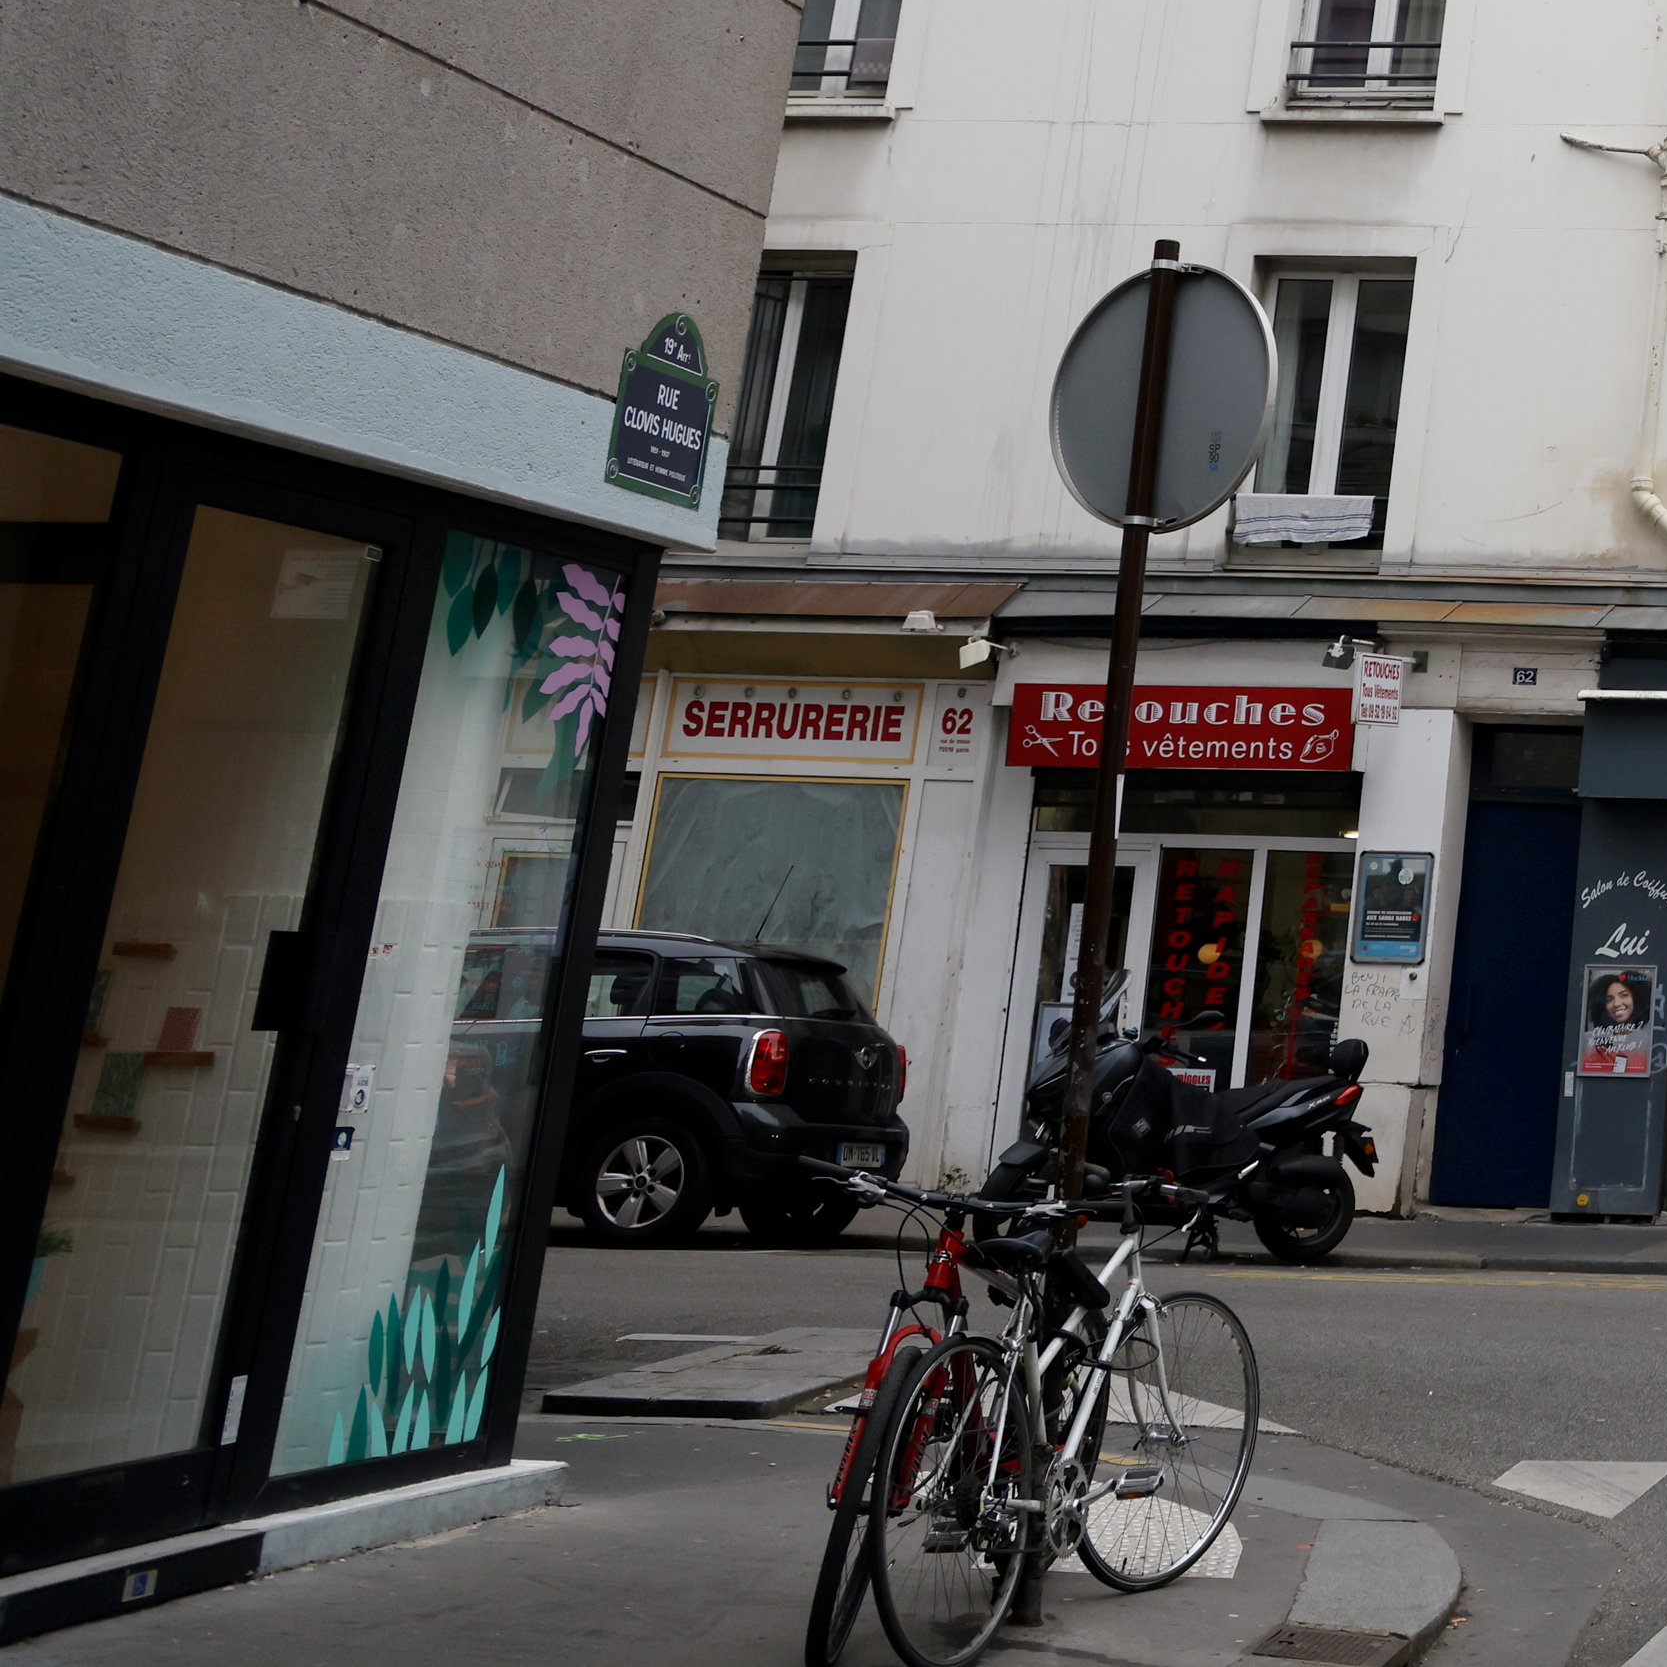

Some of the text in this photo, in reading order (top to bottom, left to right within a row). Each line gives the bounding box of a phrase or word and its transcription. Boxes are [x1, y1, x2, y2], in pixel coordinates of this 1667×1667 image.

[656, 383, 681, 411] RUE
[624, 405, 702, 450] CLOVIS HUGUES
[1364, 660, 1400, 680] RETOUCHES
[1516, 670, 1535, 683] 62
[1362, 682, 1373, 698] Tous
[682, 700, 906, 742] SERRURERIE
[942, 708, 973, 735] 62
[1039, 690, 1326, 727] Reouches
[1142, 733, 1293, 760] vêtements
[1581, 879, 1613, 909] Salon
[1616, 871, 1630, 887] de
[1595, 922, 1650, 958] Lui
[1361, 1011, 1391, 1028] RUE
[1375, 1000, 1391, 1012] LA
